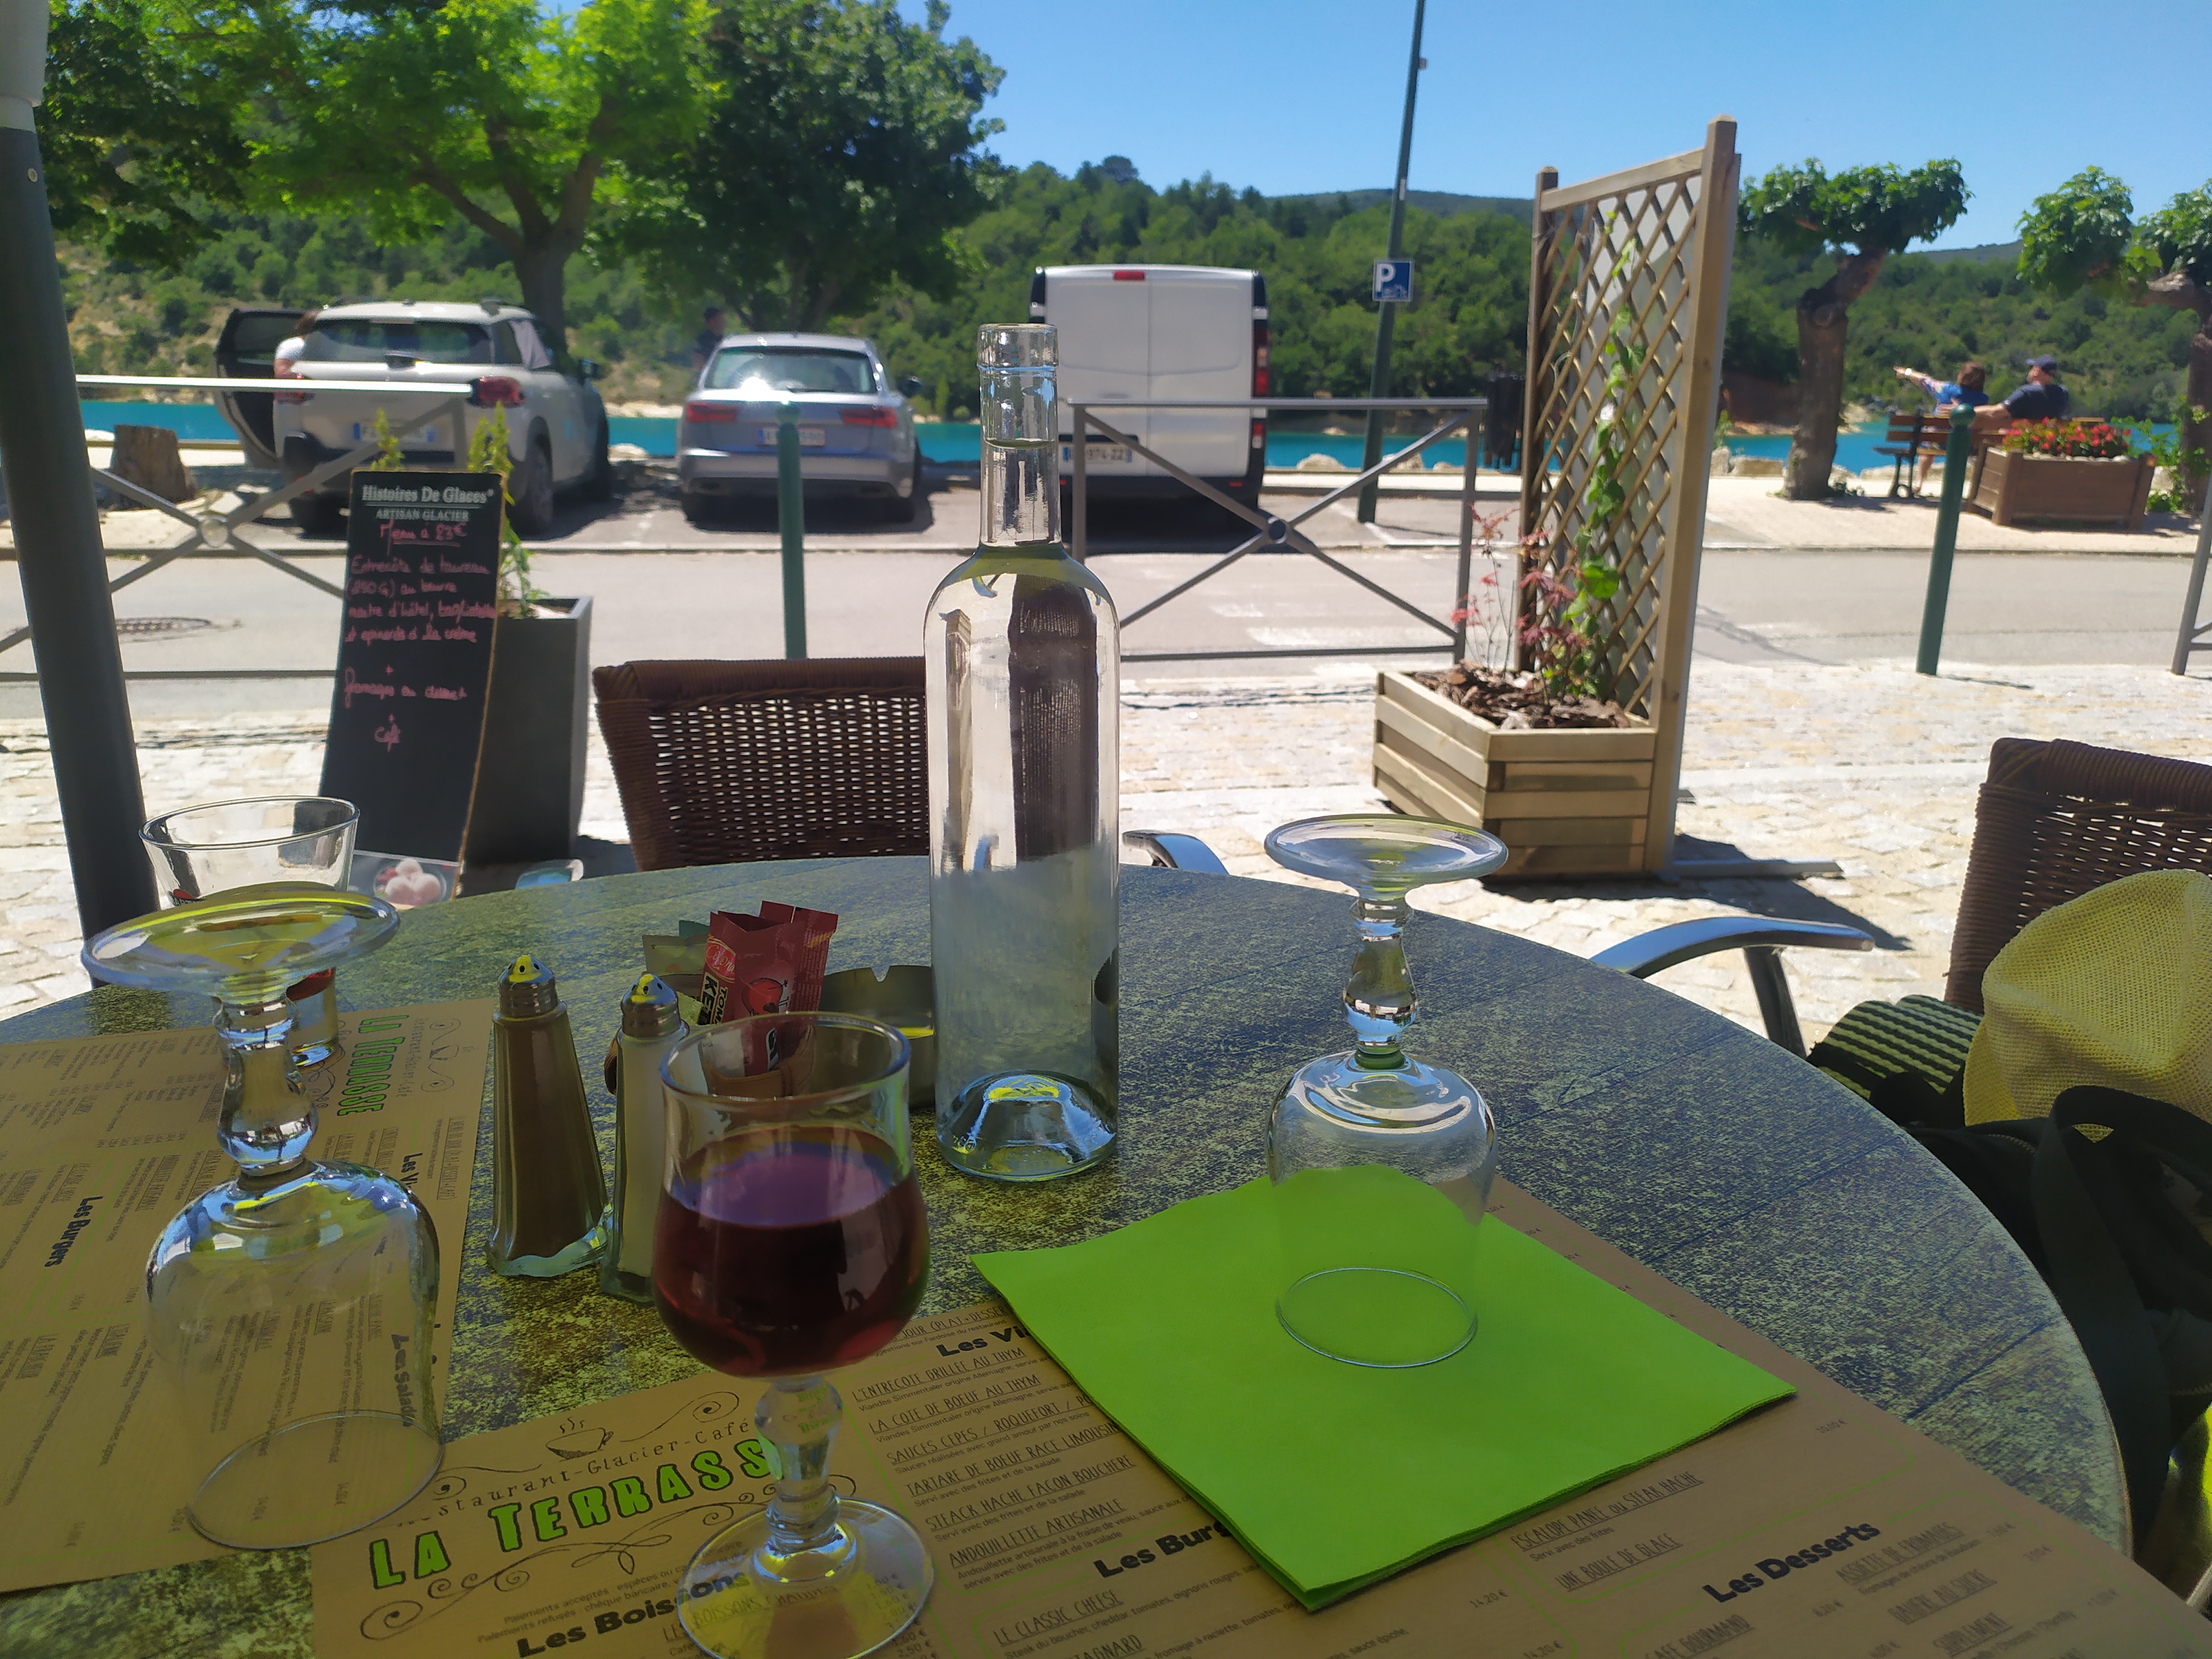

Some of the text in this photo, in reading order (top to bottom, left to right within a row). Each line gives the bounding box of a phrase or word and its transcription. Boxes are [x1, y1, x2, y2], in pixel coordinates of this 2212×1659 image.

[1375, 263, 1396, 292] P
[362, 484, 418, 502] Histoires
[421, 486, 441, 502] De
[376, 509, 469, 521] ARTISAN GLACIER
[400, 1152, 423, 1173] Les
[44, 1195, 103, 1267] Les Burgers
[852, 1347, 1026, 1402] L'ENTRECOTE GRILLEE AU THYM
[936, 1337, 988, 1357] Les
[858, 1398, 892, 1412] Viandes
[891, 1383, 943, 1402] Simmentaler
[944, 1376, 971, 1387] origine
[868, 1374, 1041, 1435] LA COTE DE BOEUF AU THYM
[875, 1385, 1059, 1443] Viandes Simmentaler origine servie
[886, 1402, 1061, 1465] SAUCES CEPES ROQUEFORT
[894, 1460, 927, 1474] Sauces
[965, 1442, 985, 1453] avec
[986, 1433, 1011, 1447] grand
[1010, 1426, 1037, 1439] amour
[1037, 1422, 1051, 1432] par
[1052, 1417, 1068, 1426] nos
[1067, 1411, 1090, 1421] soins
[397, 1418, 750, 1525] staurant-Glacier-Café
[906, 1439, 1061, 1497] TARTARE DE BOEUF RACE
[913, 1494, 938, 1507] Servi
[939, 1488, 960, 1500] avec
[960, 1483, 977, 1493] des
[977, 1475, 1001, 1486] frites
[1001, 1471, 1012, 1479] et
[1011, 1468, 1024, 1476] de
[1033, 1457, 1061, 1469] salade
[925, 1455, 1135, 1532] STEACK HACHE FACON BOUCHERE
[369, 1438, 775, 1589] LA TERRASS
[934, 1528, 959, 1542] Servi
[959, 1522, 982, 1534] avec
[982, 1516, 999, 1527] des
[999, 1508, 1024, 1520] frites
[1024, 1504, 1036, 1512] et
[1035, 1500, 1047, 1509] de
[1057, 1489, 1086, 1501] salade
[949, 1499, 1125, 1568] ANDOUILLETTE ARTISANALE
[1510, 1470, 1702, 1550] ESCALOPE PANEE ou STEAK HACHE
[957, 1556, 1013, 1579] Andouillette
[1014, 1540, 1059, 1560] artisanale
[1101, 1521, 1114, 1530] de
[963, 1575, 992, 1590] servie
[993, 1567, 1014, 1579] avec
[1015, 1561, 1034, 1572] des
[1032, 1552, 1059, 1565] frites
[1058, 1548, 1071, 1557] et
[1070, 1543, 1083, 1553] de
[1092, 1531, 1122, 1545] salade
[1093, 1548, 1156, 1578] Les
[1528, 1526, 1615, 1562] Servi avec des frites
[1554, 1532, 1680, 1592] UNE BOULE DE GLACE
[1702, 1573, 1764, 1603] Les
[1756, 1524, 1879, 1579] Desserts
[516, 1626, 586, 1657] Les
[992, 1589, 1124, 1647] LE CLASSIC CHEESE
